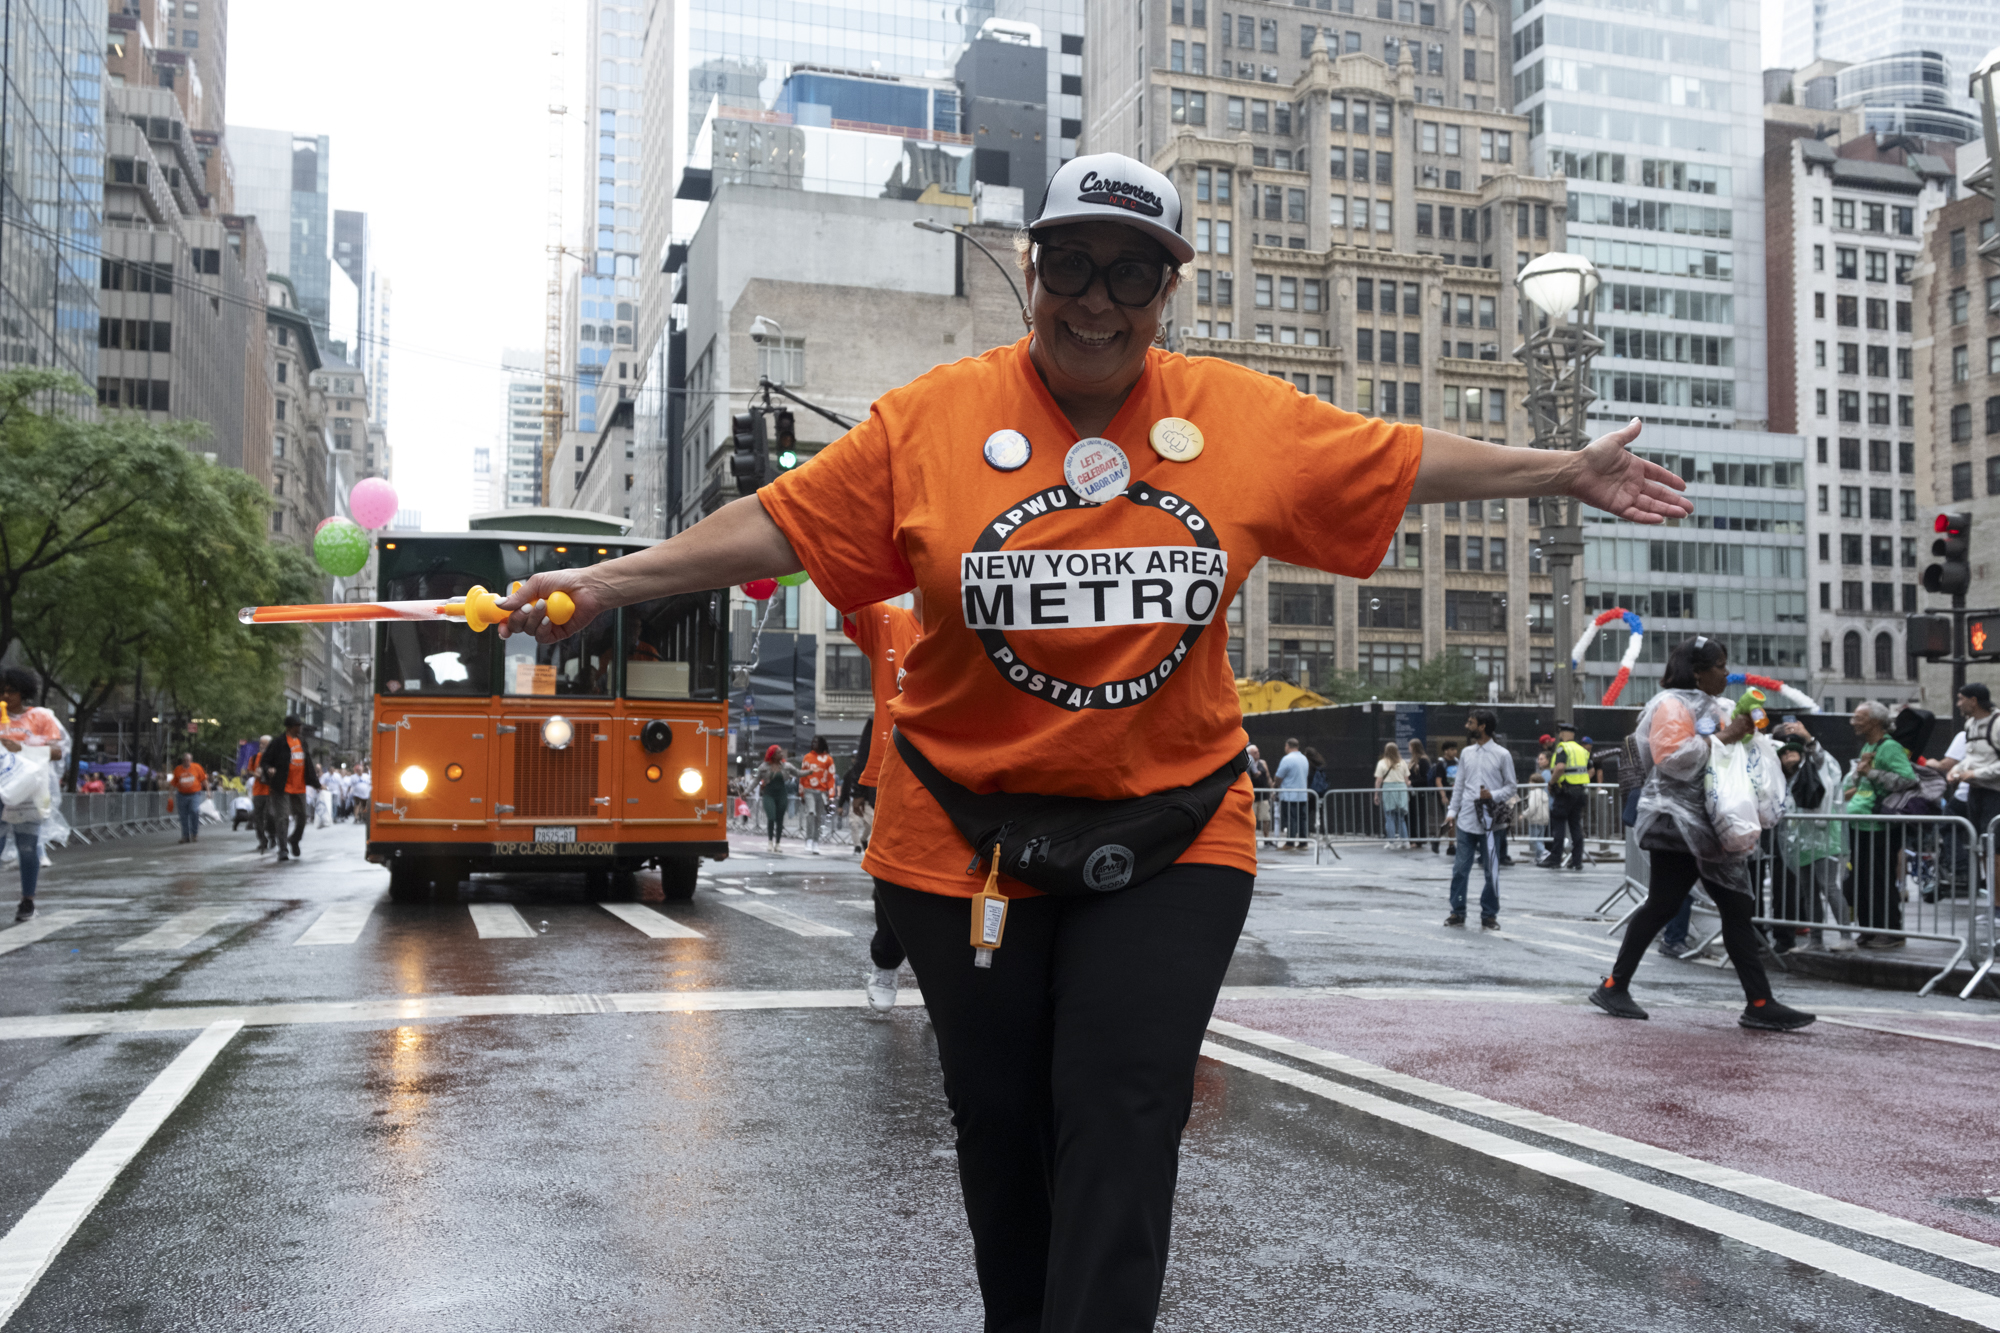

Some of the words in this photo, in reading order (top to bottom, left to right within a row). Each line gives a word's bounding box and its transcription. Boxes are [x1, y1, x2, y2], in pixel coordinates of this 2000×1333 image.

[1080, 171, 1163, 209] Carpenters
[1109, 195, 1137, 209] NYC
[1071, 442, 1086, 455] POSTAL
[1080, 451, 1103, 469] LET'S
[1077, 457, 1119, 485] CELEBRATE
[1084, 476, 1111, 496] LABOR
[1108, 468, 1125, 483] DAY
[992, 489, 1068, 538] APWU
[1159, 495, 1205, 531] CIO
[964, 554, 1035, 580] NEW
[1045, 551, 1135, 577] YORK
[1145, 550, 1225, 577] AREA
[964, 578, 1219, 626] METRO
[993, 646, 1094, 708] POSTAL
[1105, 640, 1187, 704] UNION
[494, 843, 516, 855] TOP
[519, 843, 556, 855] CLASS
[560, 843, 614, 855] LIMO.COM
[1097, 862, 1122, 875] APWU
[1099, 878, 1125, 890] COPA
